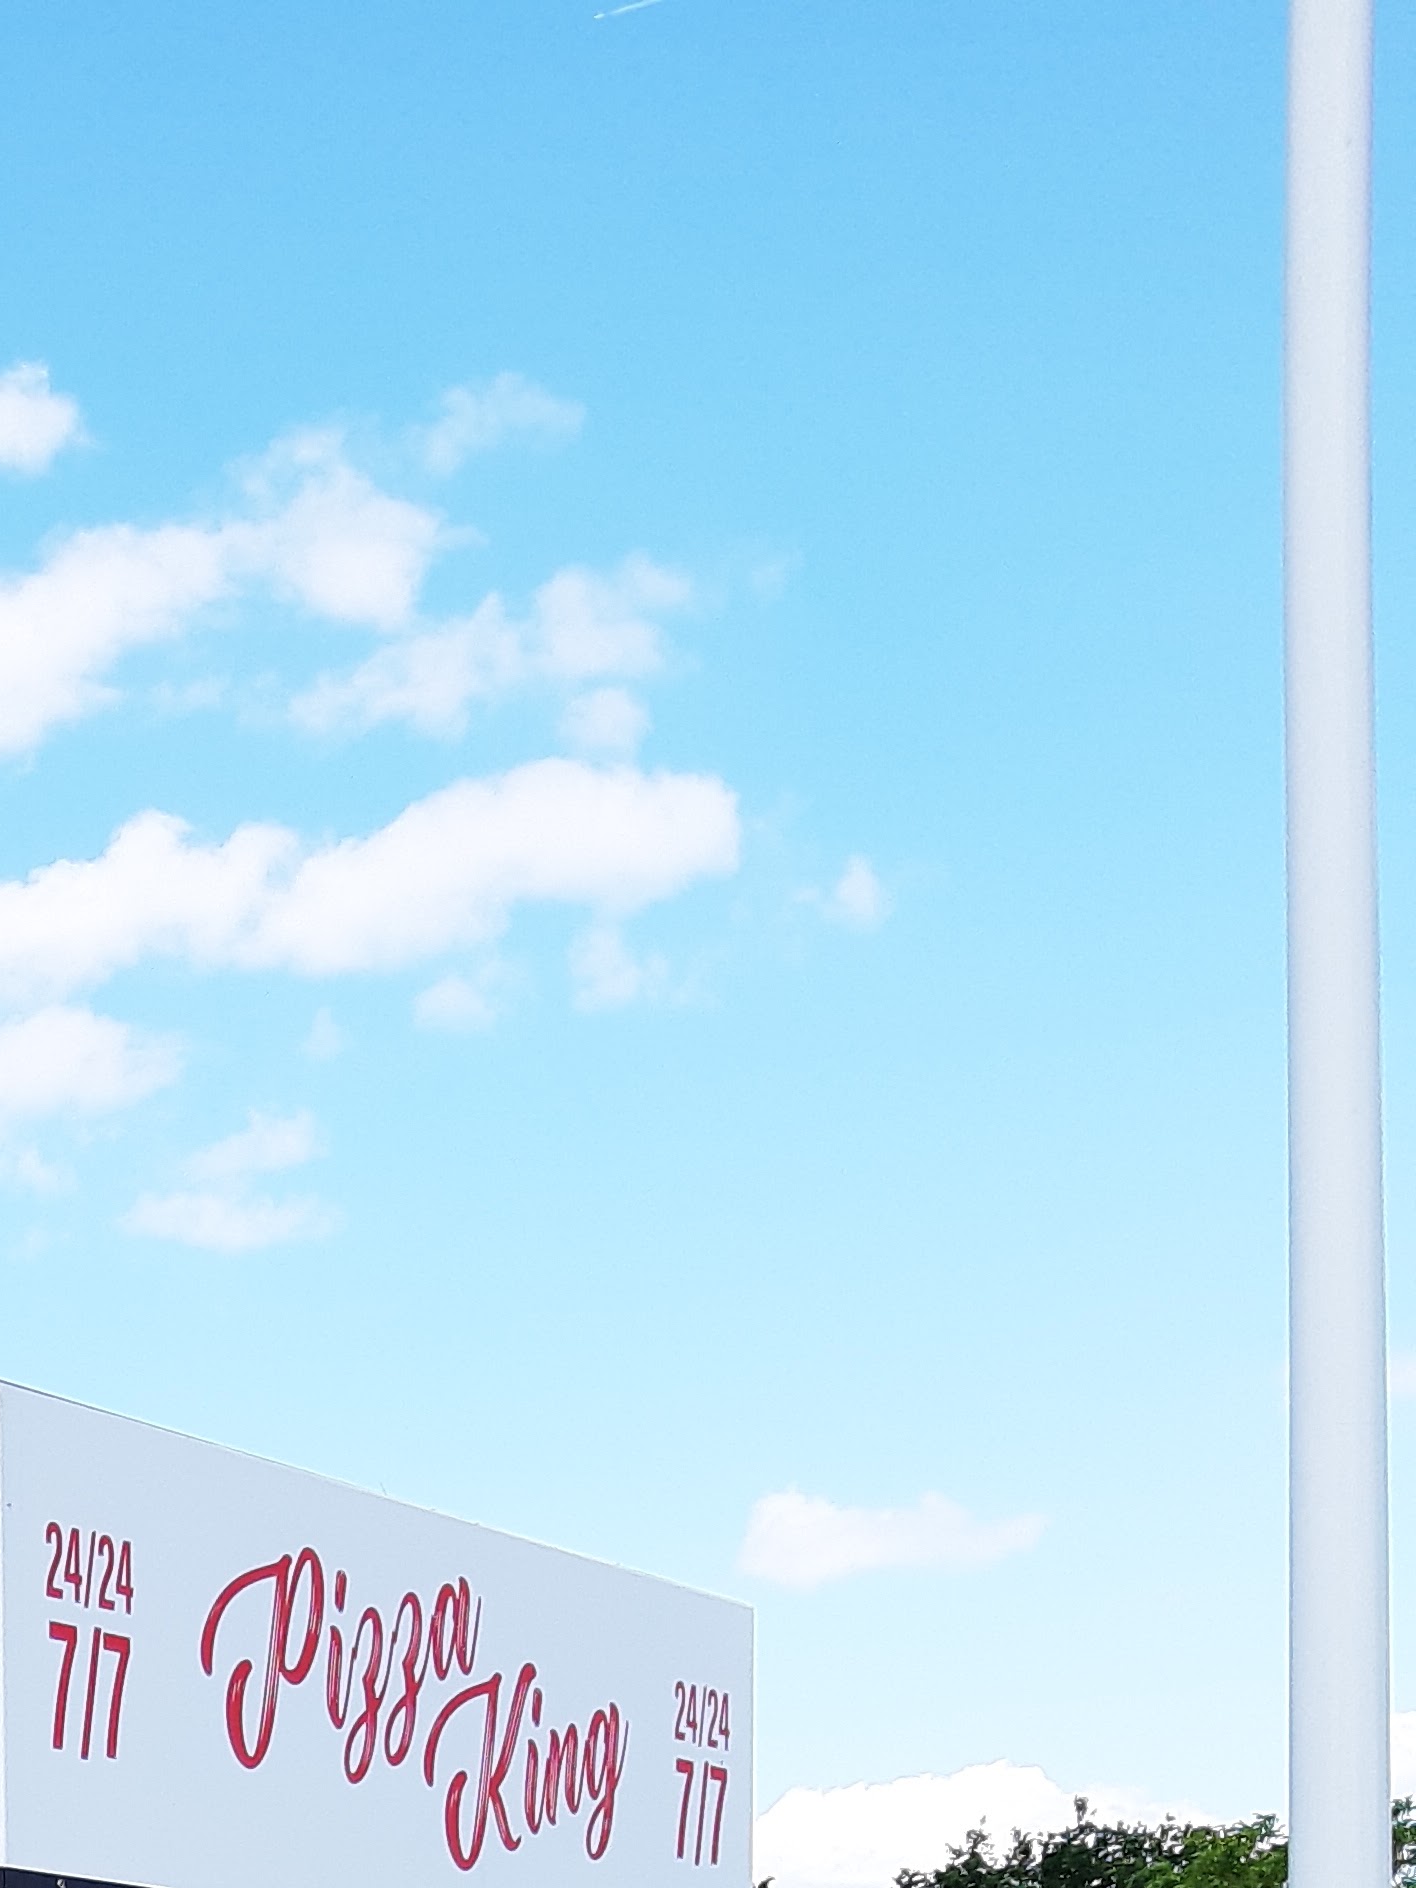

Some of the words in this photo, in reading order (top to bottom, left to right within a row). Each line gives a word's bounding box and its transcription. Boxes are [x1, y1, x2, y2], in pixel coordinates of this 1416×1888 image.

[46, 1522, 134, 1616] 24/24
[48, 1620, 131, 1760] 7/7
[200, 1548, 481, 1784] Pizza
[673, 1680, 731, 1752] 24/24
[424, 1662, 629, 1871] King
[674, 1759, 729, 1866] 7/7
